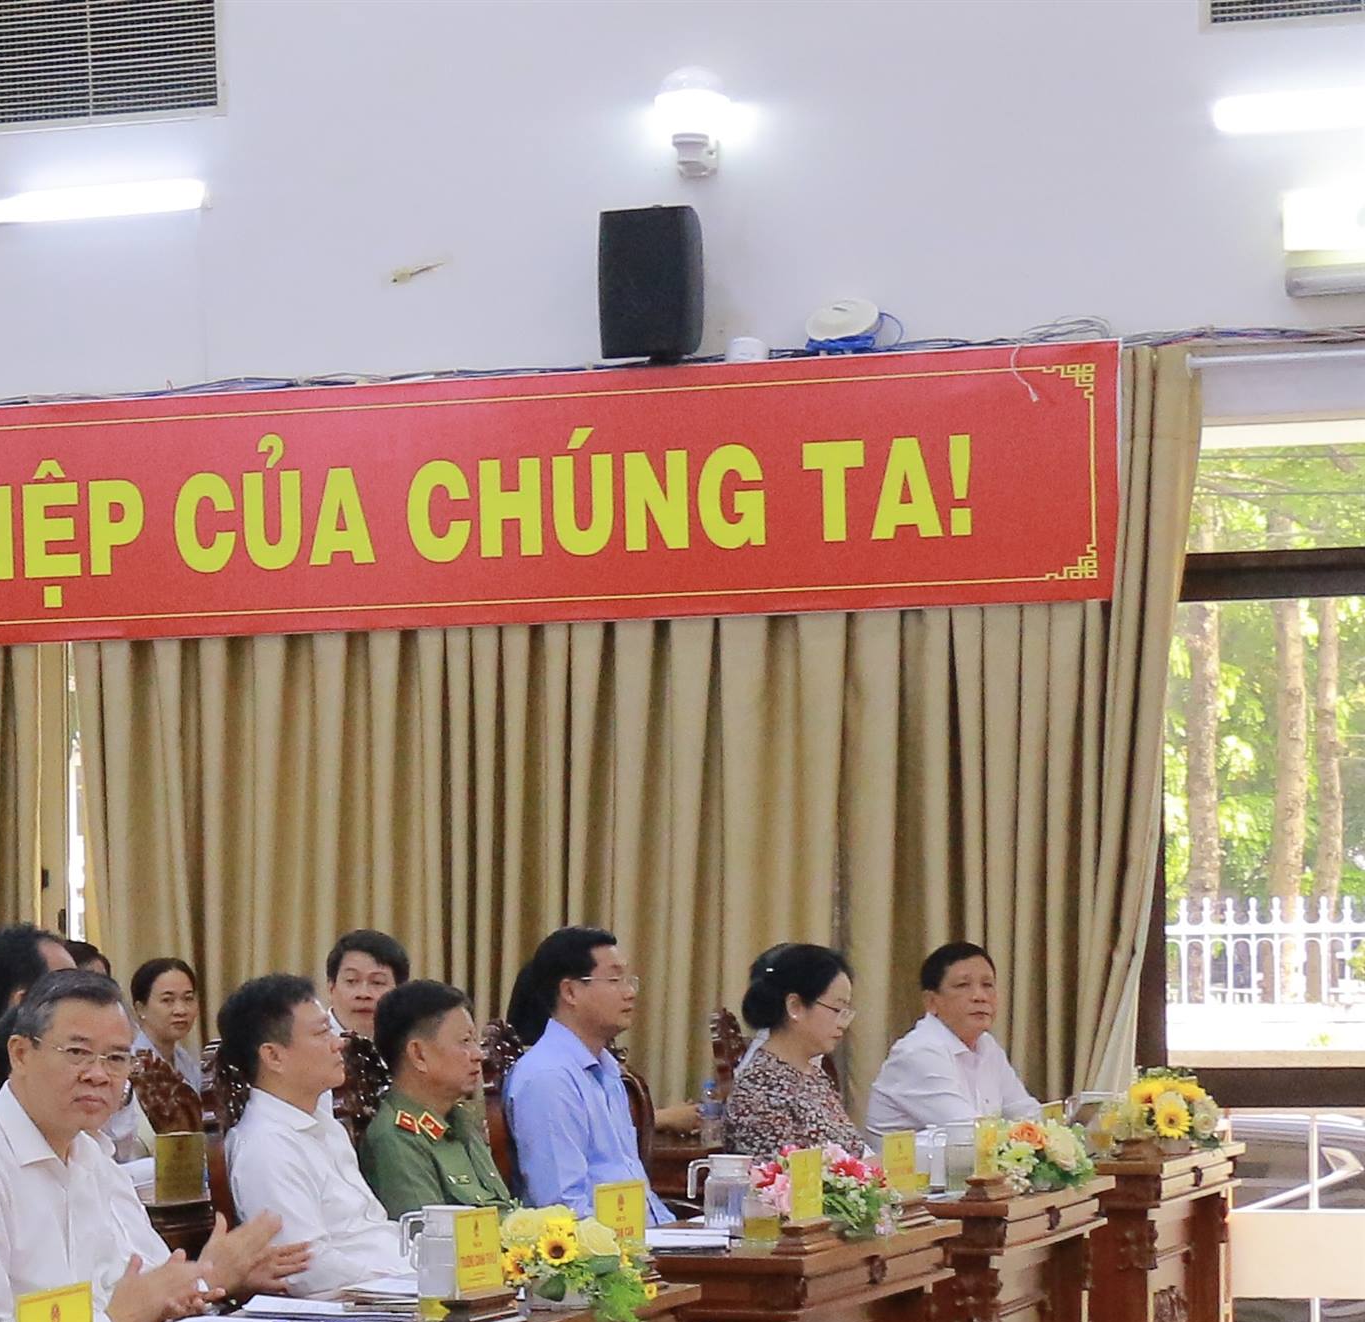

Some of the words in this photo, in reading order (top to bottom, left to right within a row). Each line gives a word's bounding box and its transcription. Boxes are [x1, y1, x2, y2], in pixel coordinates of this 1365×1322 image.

[174, 433, 376, 573] CỦA
[407, 427, 766, 563] CHÚNG
[802, 434, 972, 542] TA!
